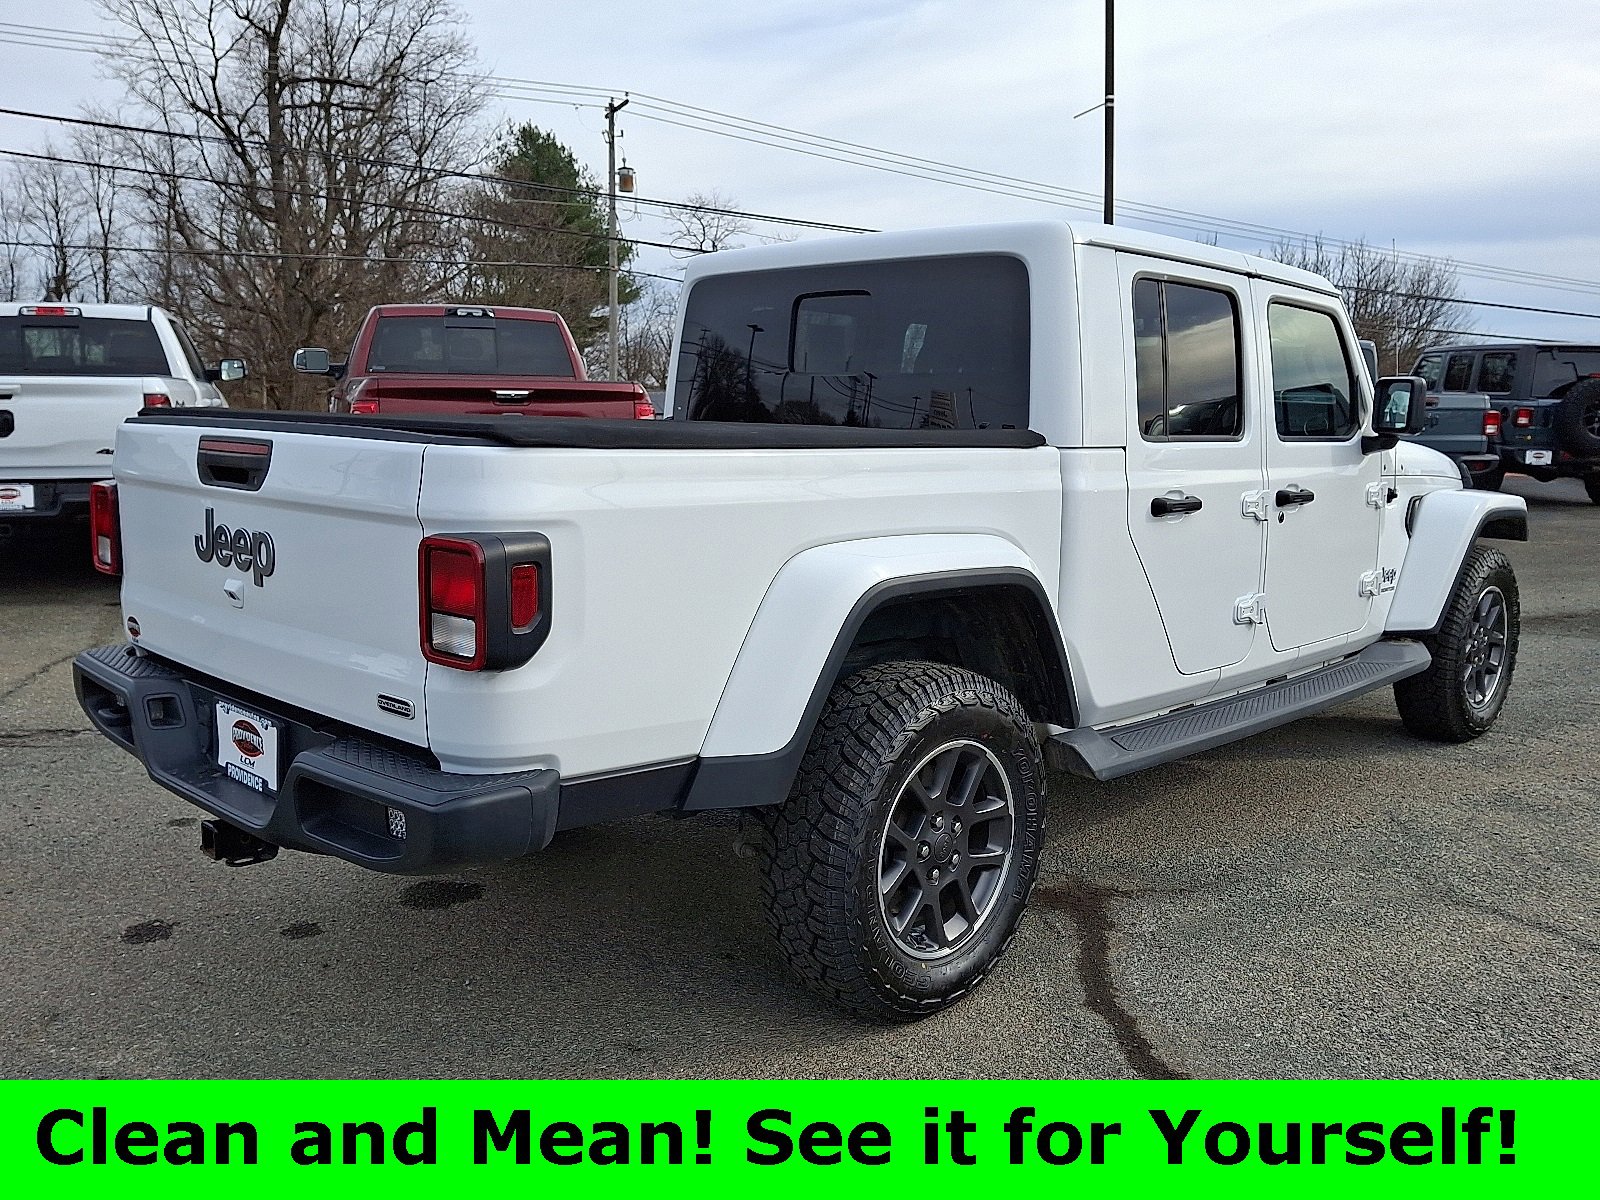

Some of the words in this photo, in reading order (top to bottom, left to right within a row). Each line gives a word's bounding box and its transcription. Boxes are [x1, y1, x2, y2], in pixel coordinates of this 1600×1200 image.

[194, 507, 276, 587] Jeep
[377, 699, 411, 713] OVERLAND
[232, 726, 265, 755] PROVIDENCE
[227, 763, 264, 792] PROVIDENCE
[1012, 748, 1038, 900] YOKOHAMA
